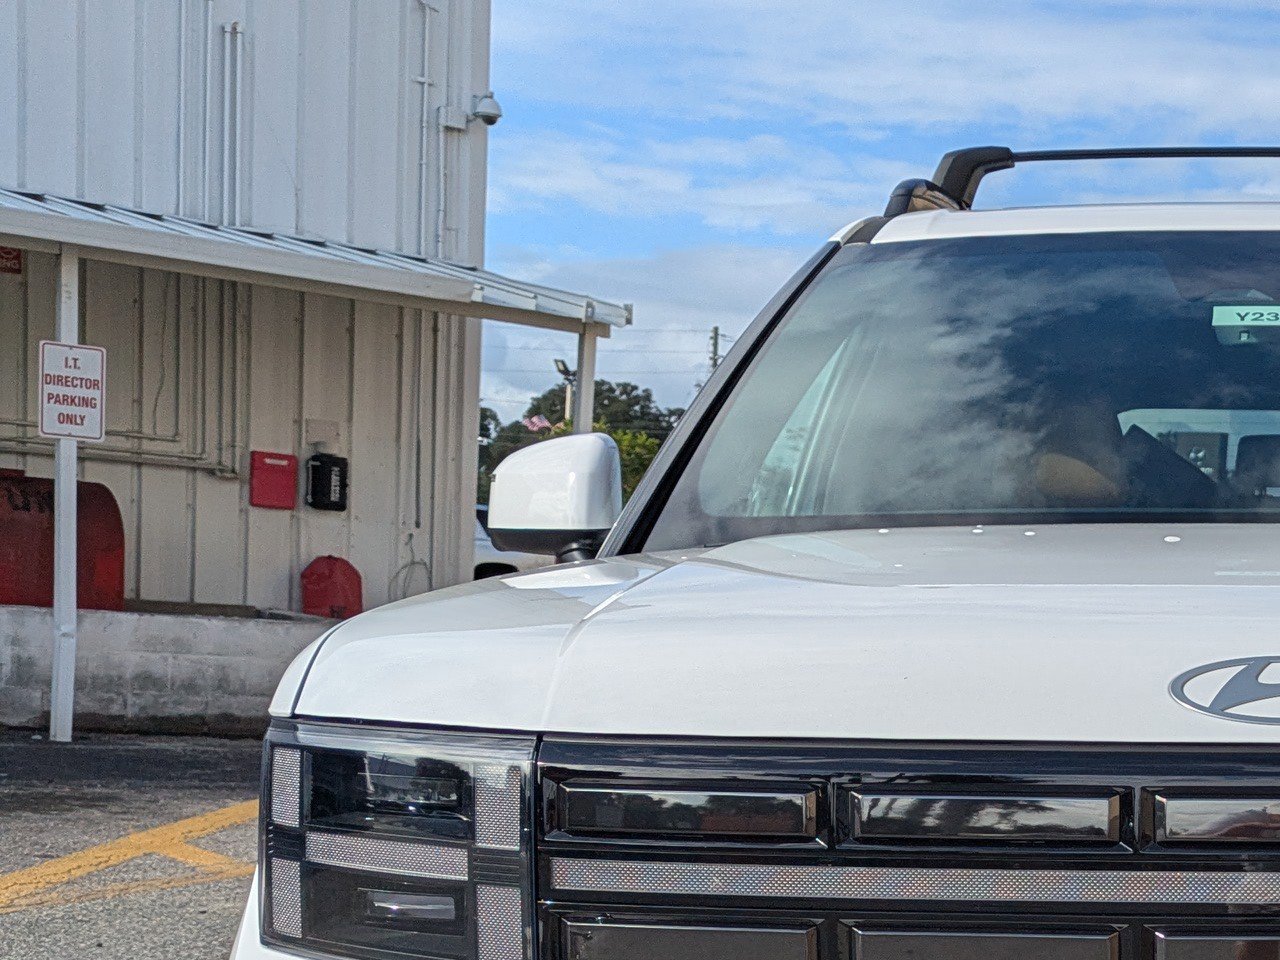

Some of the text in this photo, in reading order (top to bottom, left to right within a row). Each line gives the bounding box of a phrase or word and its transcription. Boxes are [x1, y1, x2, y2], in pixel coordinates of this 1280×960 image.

[64, 356, 81, 370] I.T.
[44, 373, 100, 390] DIRECTOR
[47, 392, 97, 409] PARKING
[57, 412, 86, 426] ONLY
